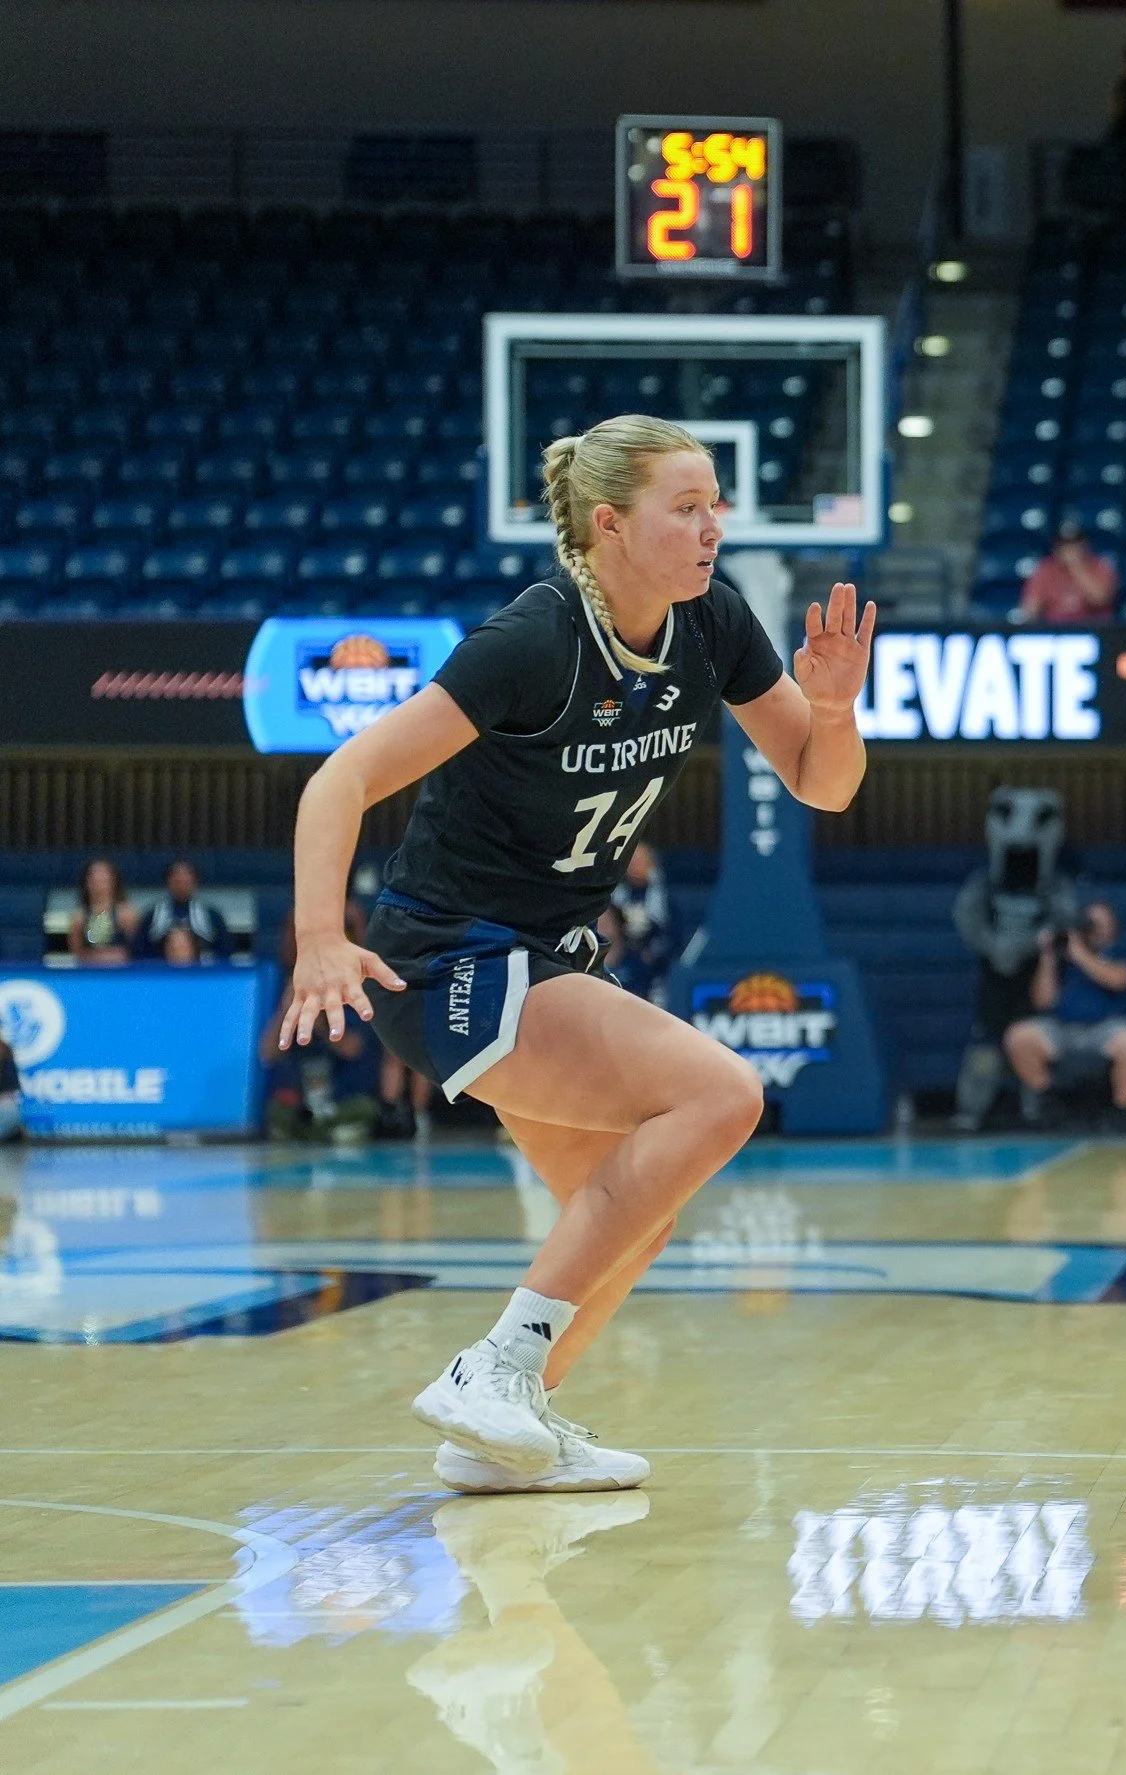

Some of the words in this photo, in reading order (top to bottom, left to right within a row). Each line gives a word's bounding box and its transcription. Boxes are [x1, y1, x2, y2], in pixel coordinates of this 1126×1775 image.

[662, 132, 765, 183] 5:54
[647, 179, 752, 260] 21
[300, 667, 418, 701] WBIT
[593, 708, 622, 717] WBIT
[561, 743, 605, 773] UC
[611, 722, 697, 771] IRVINE
[551, 776, 665, 873] 14
[693, 1012, 837, 1050] WBIT
